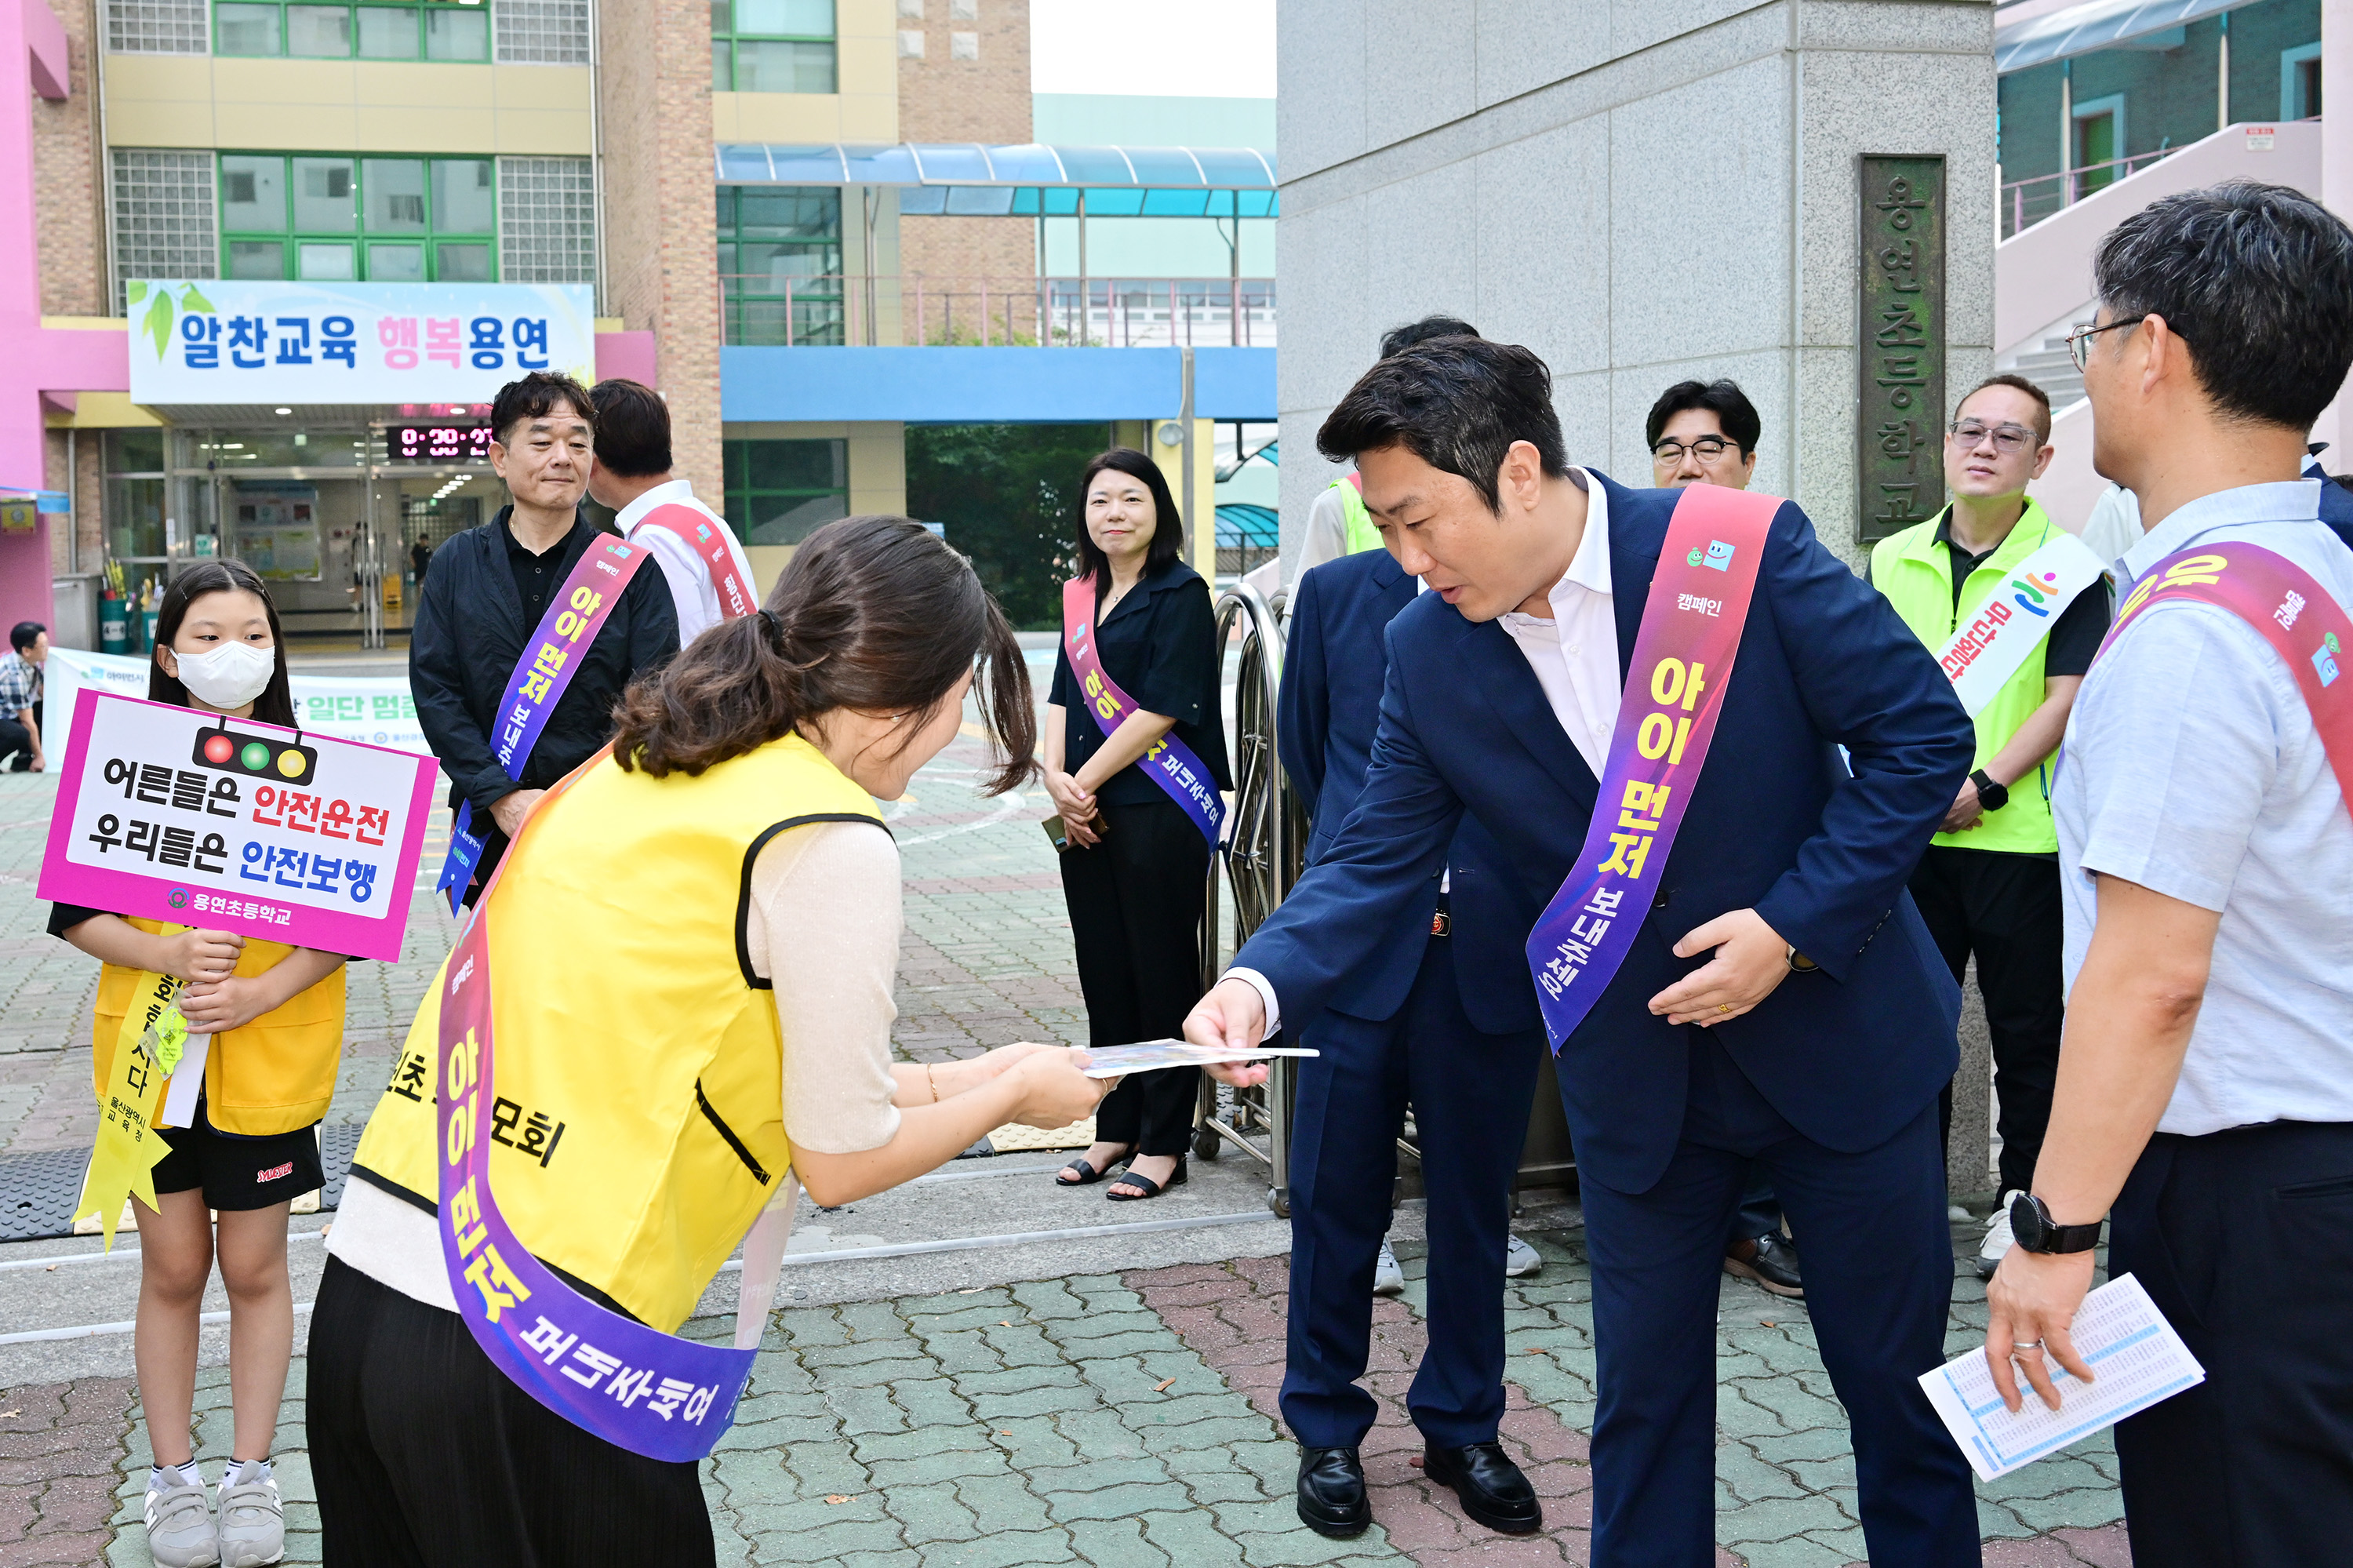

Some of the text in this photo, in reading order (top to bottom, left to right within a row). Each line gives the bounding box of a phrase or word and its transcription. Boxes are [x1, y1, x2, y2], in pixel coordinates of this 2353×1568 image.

[181, 315, 550, 371] 알찬교육 행복용연
[1876, 176, 1927, 523] 용연초등학교
[596, 559, 620, 577] 캠페인
[723, 573, 747, 619] 횡단
[1677, 592, 1722, 618] 캠페인
[2272, 589, 2306, 631] 캠페인
[497, 586, 602, 773] 아이 먼저 보내주
[307, 696, 365, 721] 일단
[1085, 668, 1220, 827] 아이 보내주세요
[104, 758, 391, 847] 어른들은 안전운전
[1537, 657, 1706, 1002] 아이 먼저 보내주세요
[89, 813, 377, 903] 우리들은 안전보행
[460, 831, 482, 852] 울산광역시
[193, 893, 292, 926] 용연초등학교
[111, 1096, 147, 1130] 울산광역시
[490, 1095, 566, 1169] 모회
[448, 1026, 720, 1427] 아이 먼저 보내주세요
